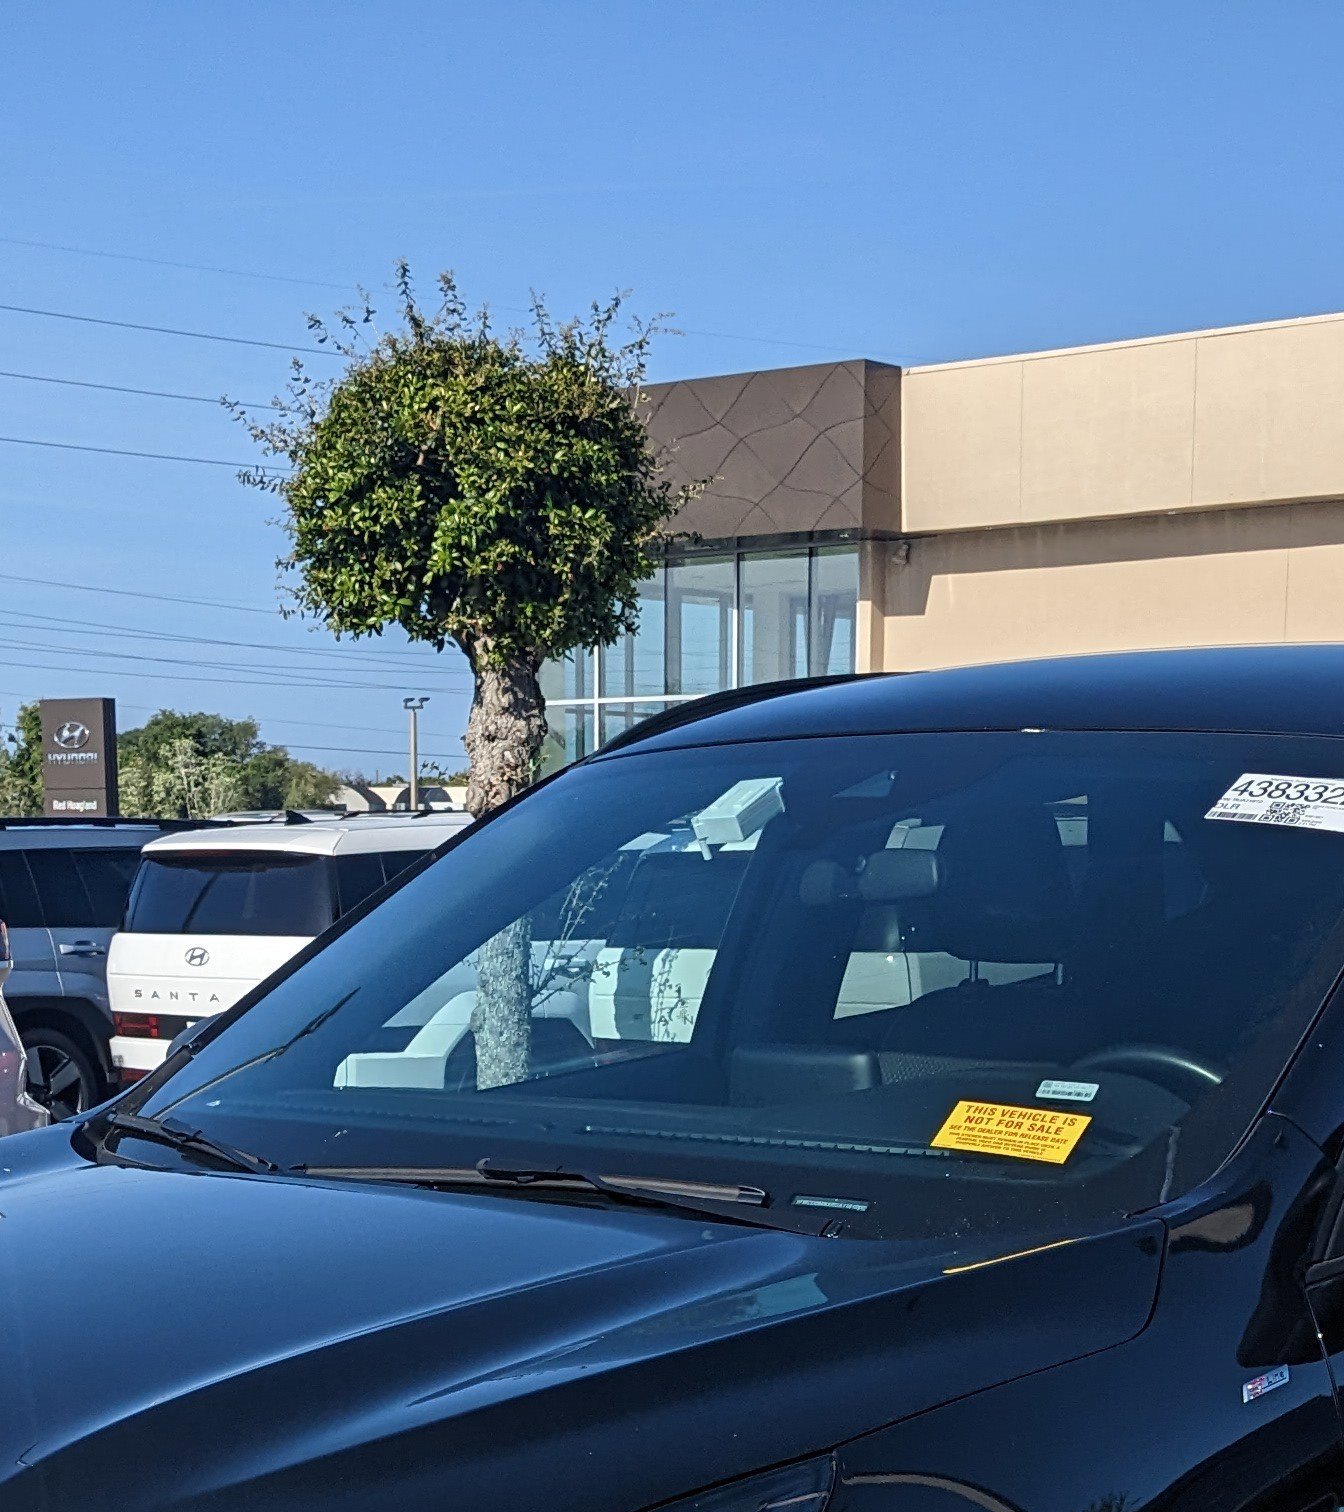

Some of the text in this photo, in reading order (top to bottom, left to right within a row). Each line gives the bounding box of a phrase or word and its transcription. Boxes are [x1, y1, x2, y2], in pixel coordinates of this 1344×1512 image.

[47, 752, 98, 764] HYUNDAI
[134, 988, 221, 1003] SANTA
[964, 1105, 1078, 1125] THIS VEHICLE IS
[964, 1115, 1065, 1134] NOT FOR SALE
[1018, 1133, 1049, 1141] RELEASE
